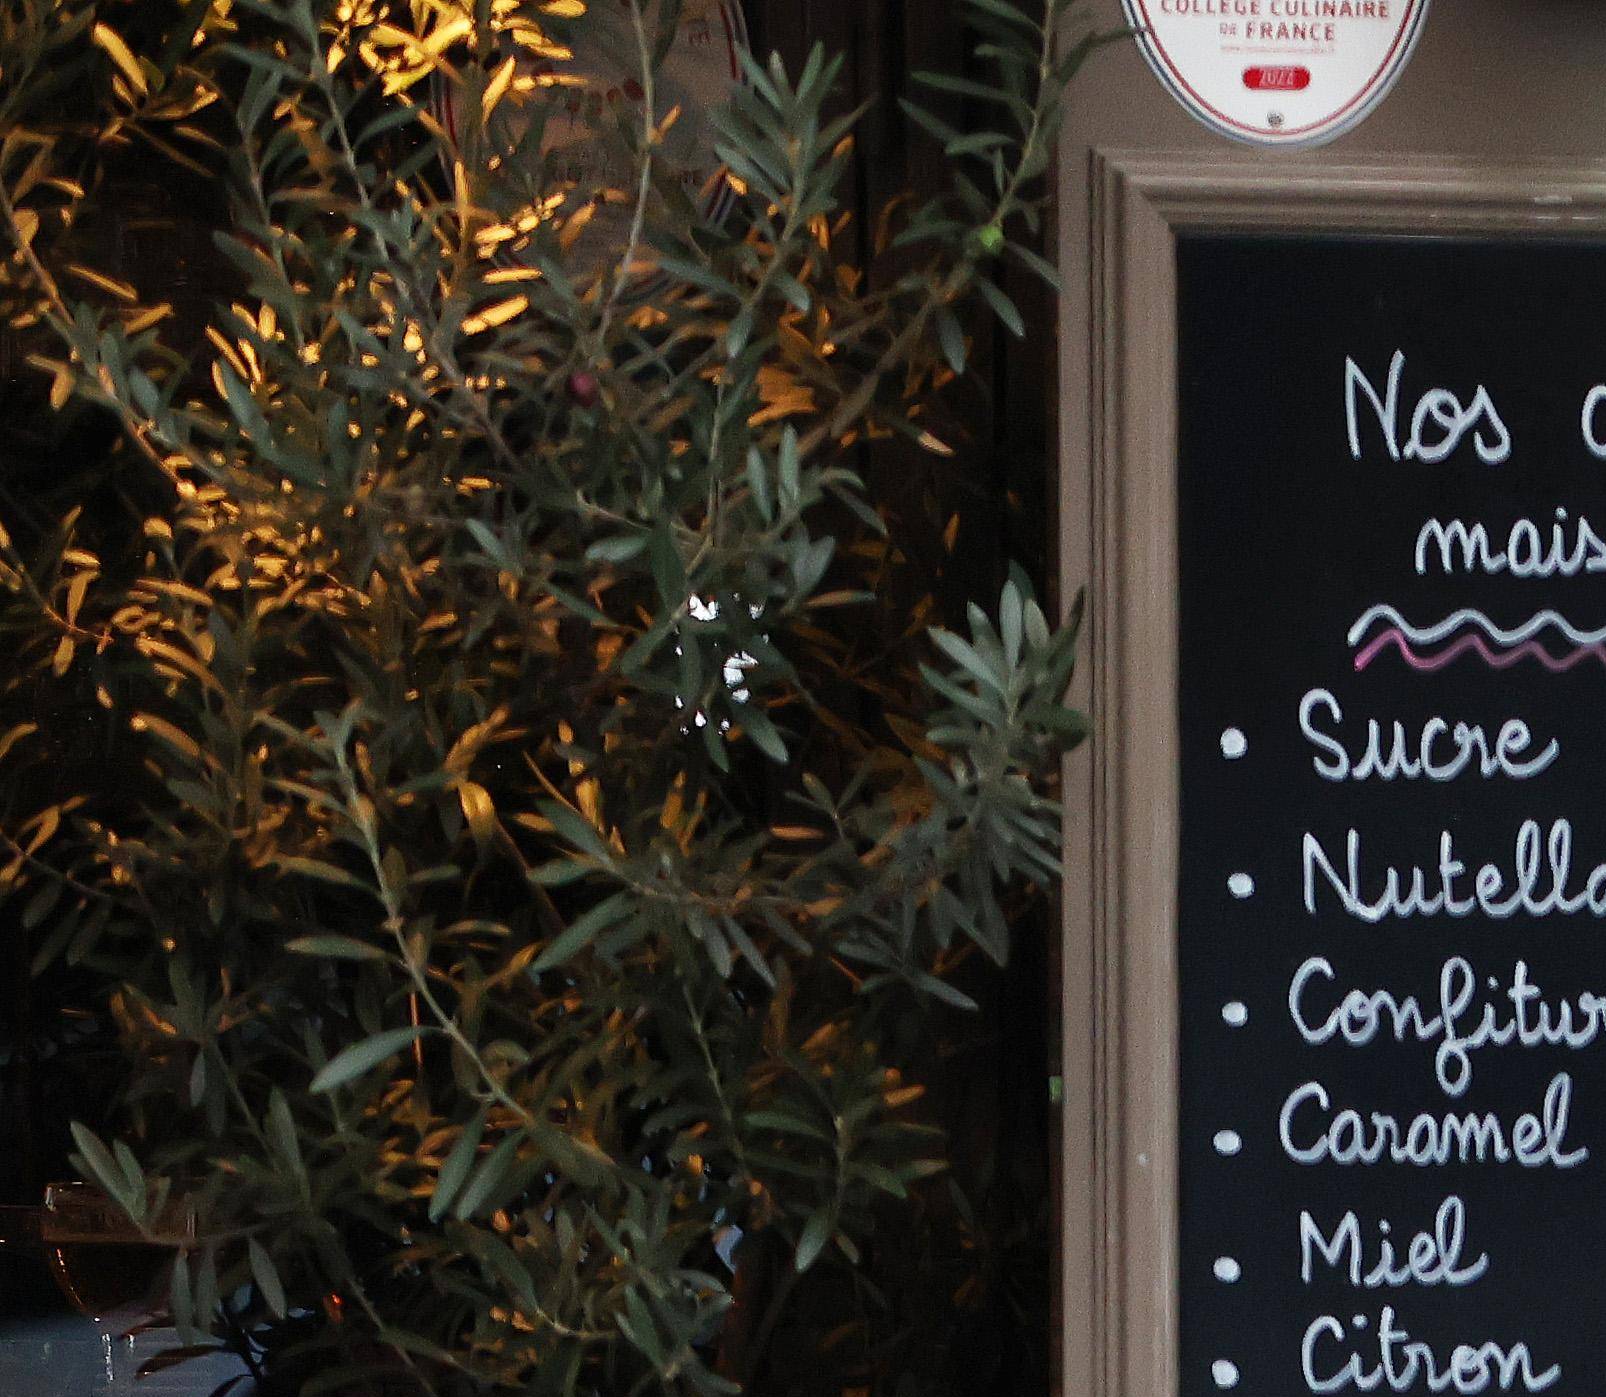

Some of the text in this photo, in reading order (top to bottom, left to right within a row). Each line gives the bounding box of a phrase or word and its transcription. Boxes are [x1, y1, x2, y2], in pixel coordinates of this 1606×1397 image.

[1246, 21, 1336, 41] FRANCE
[1345, 350, 1510, 464] Nos
[1299, 688, 1558, 780] Sucre
[1279, 1073, 1587, 1167] Caramel
[1300, 1196, 1488, 1287] Miel
[1302, 1306, 1560, 1394] Citron
